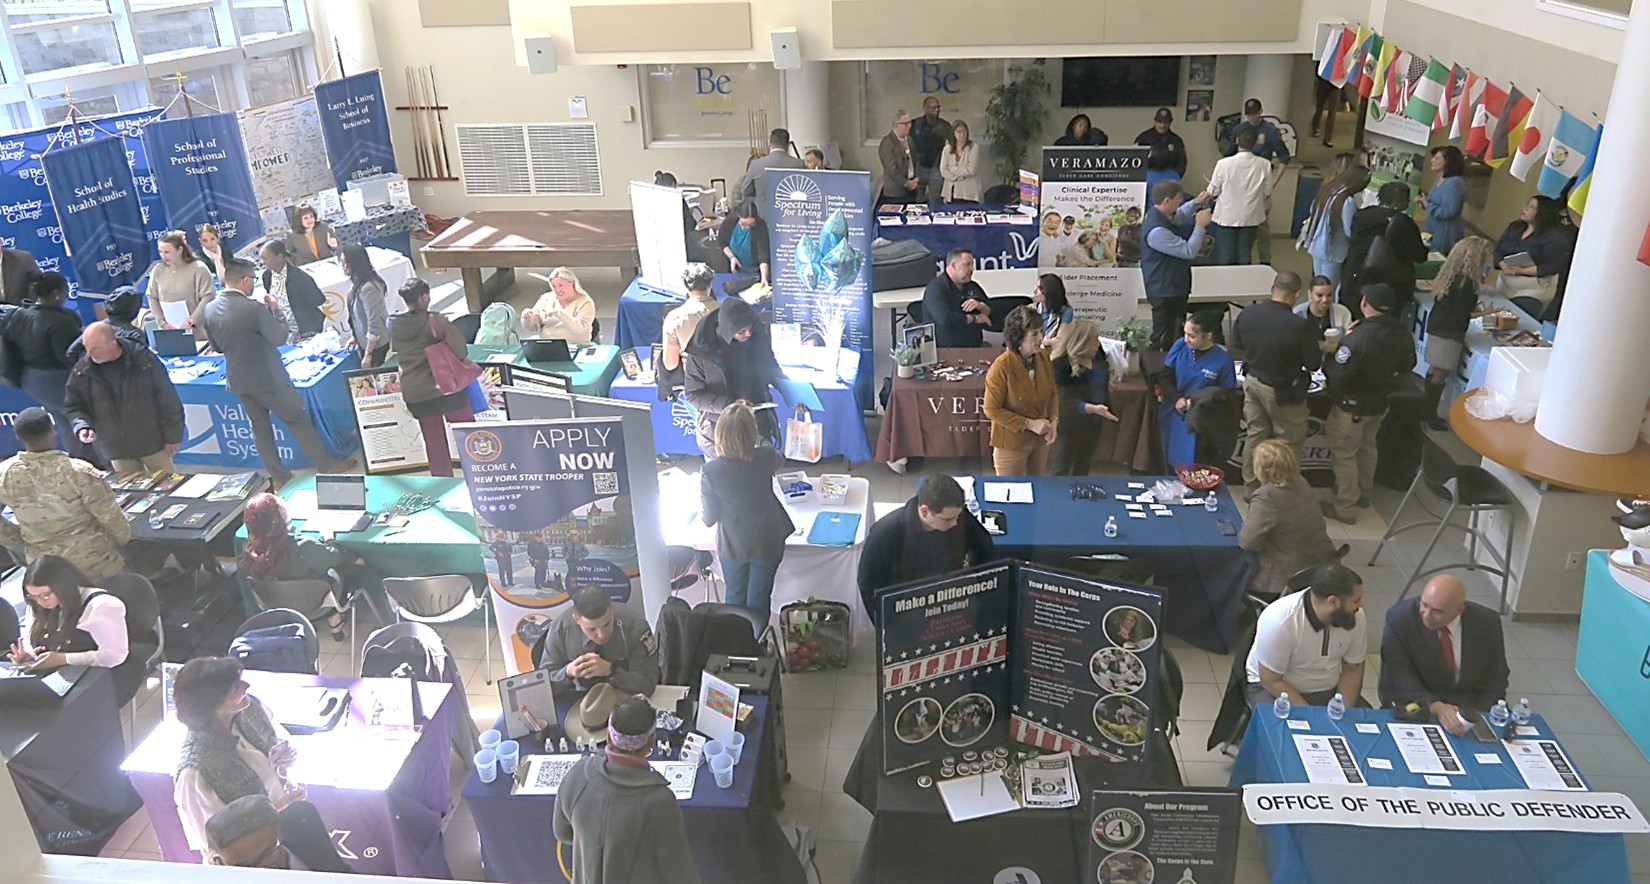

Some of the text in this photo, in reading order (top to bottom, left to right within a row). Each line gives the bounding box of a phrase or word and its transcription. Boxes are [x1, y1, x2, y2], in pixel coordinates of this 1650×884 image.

[693, 66, 733, 95] Be
[919, 63, 960, 94] Be
[327, 92, 376, 111] Larry L. Luing
[338, 104, 370, 121] School of
[342, 117, 371, 131] Business
[57, 126, 96, 142] Bereley
[174, 138, 218, 153] School of
[170, 150, 227, 166] Professional
[1049, 157, 1142, 169] VERAMAZO
[185, 164, 219, 176] Studies
[74, 177, 114, 198] School of
[1061, 186, 1128, 195] Clinical Expertise
[2, 199, 42, 216] Berkeley
[67, 190, 128, 214] Health Studies
[774, 200, 821, 211] Spectrum
[7, 208, 43, 224] College
[782, 208, 797, 217] for
[797, 209, 822, 219] Living
[203, 219, 237, 232] Brkeley
[108, 262, 134, 278] Coege
[1066, 290, 1089, 298] cierge
[1074, 306, 1108, 314] erapeutic
[220, 423, 286, 441] Heah
[532, 426, 612, 450] APPLY
[226, 440, 294, 460] Sysm
[471, 462, 517, 472] BECOME A
[558, 451, 616, 471] NOW
[473, 472, 584, 483] NEW YORK STATE TROOPER
[477, 493, 522, 502] #JoinNYSP
[575, 565, 611, 573] Why Join?
[896, 577, 998, 613] Make a Difference!
[1028, 580, 1043, 589] Your
[1044, 584, 1059, 592] Role
[1068, 589, 1080, 597] The
[1081, 592, 1101, 601] Corps
[925, 599, 970, 618] Join Today!
[1257, 794, 1632, 820] OFFICE OF THE PUBLIC DEFENDER
[1109, 820, 1126, 838] A
